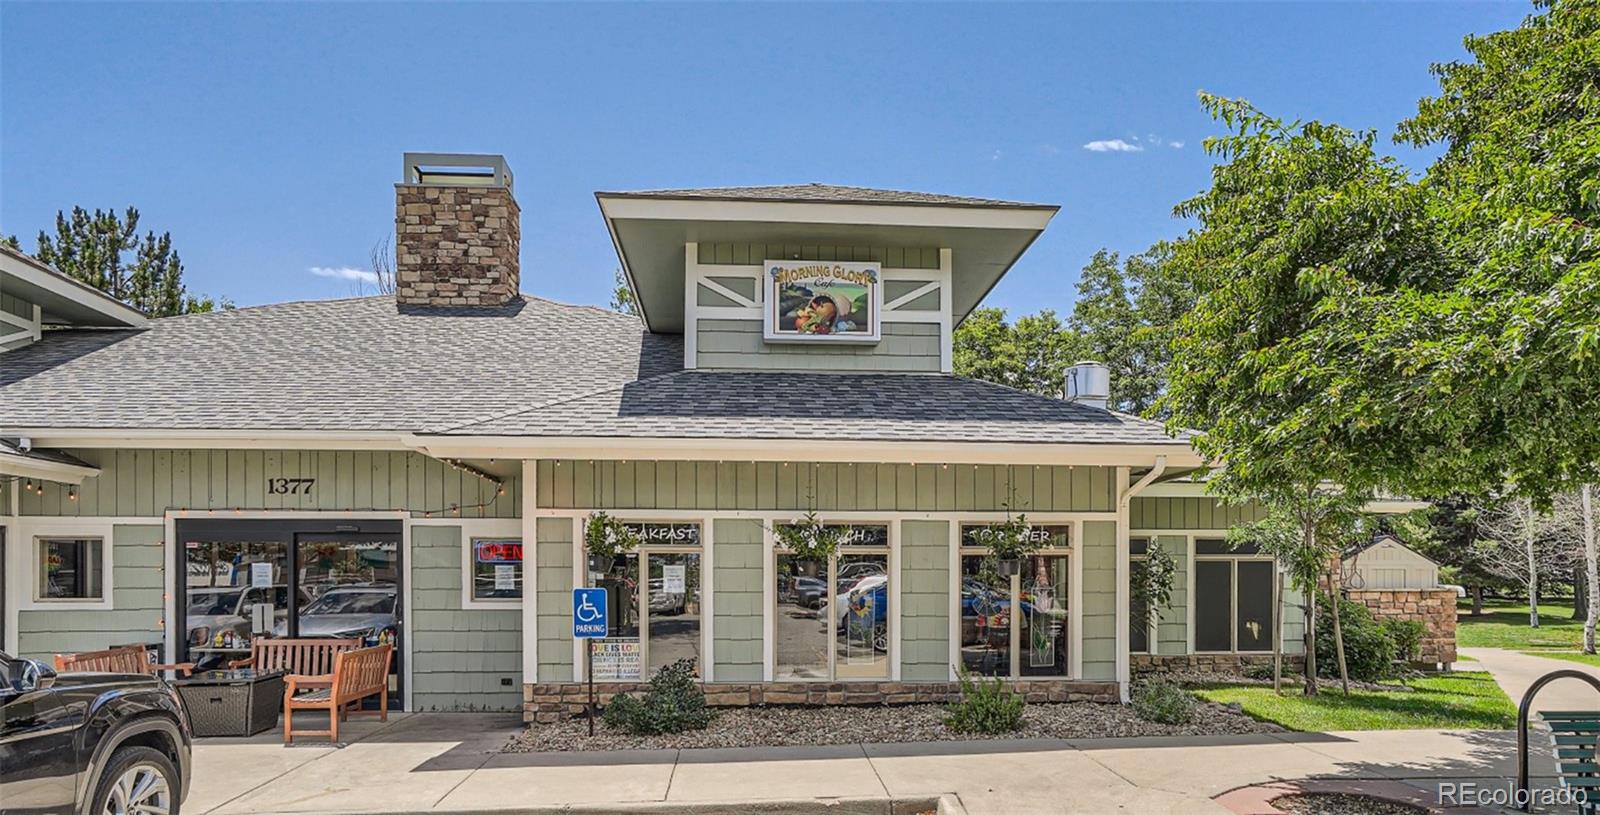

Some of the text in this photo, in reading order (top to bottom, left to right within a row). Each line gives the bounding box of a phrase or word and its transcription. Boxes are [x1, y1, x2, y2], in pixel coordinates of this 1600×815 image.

[775, 265, 830, 283] MORNING
[268, 478, 316, 495] 1377
[620, 528, 696, 541] EAKFAST
[480, 544, 524, 561] OPEN
[575, 624, 606, 634] PARKING
[591, 644, 640, 652] OVE IS LOV
